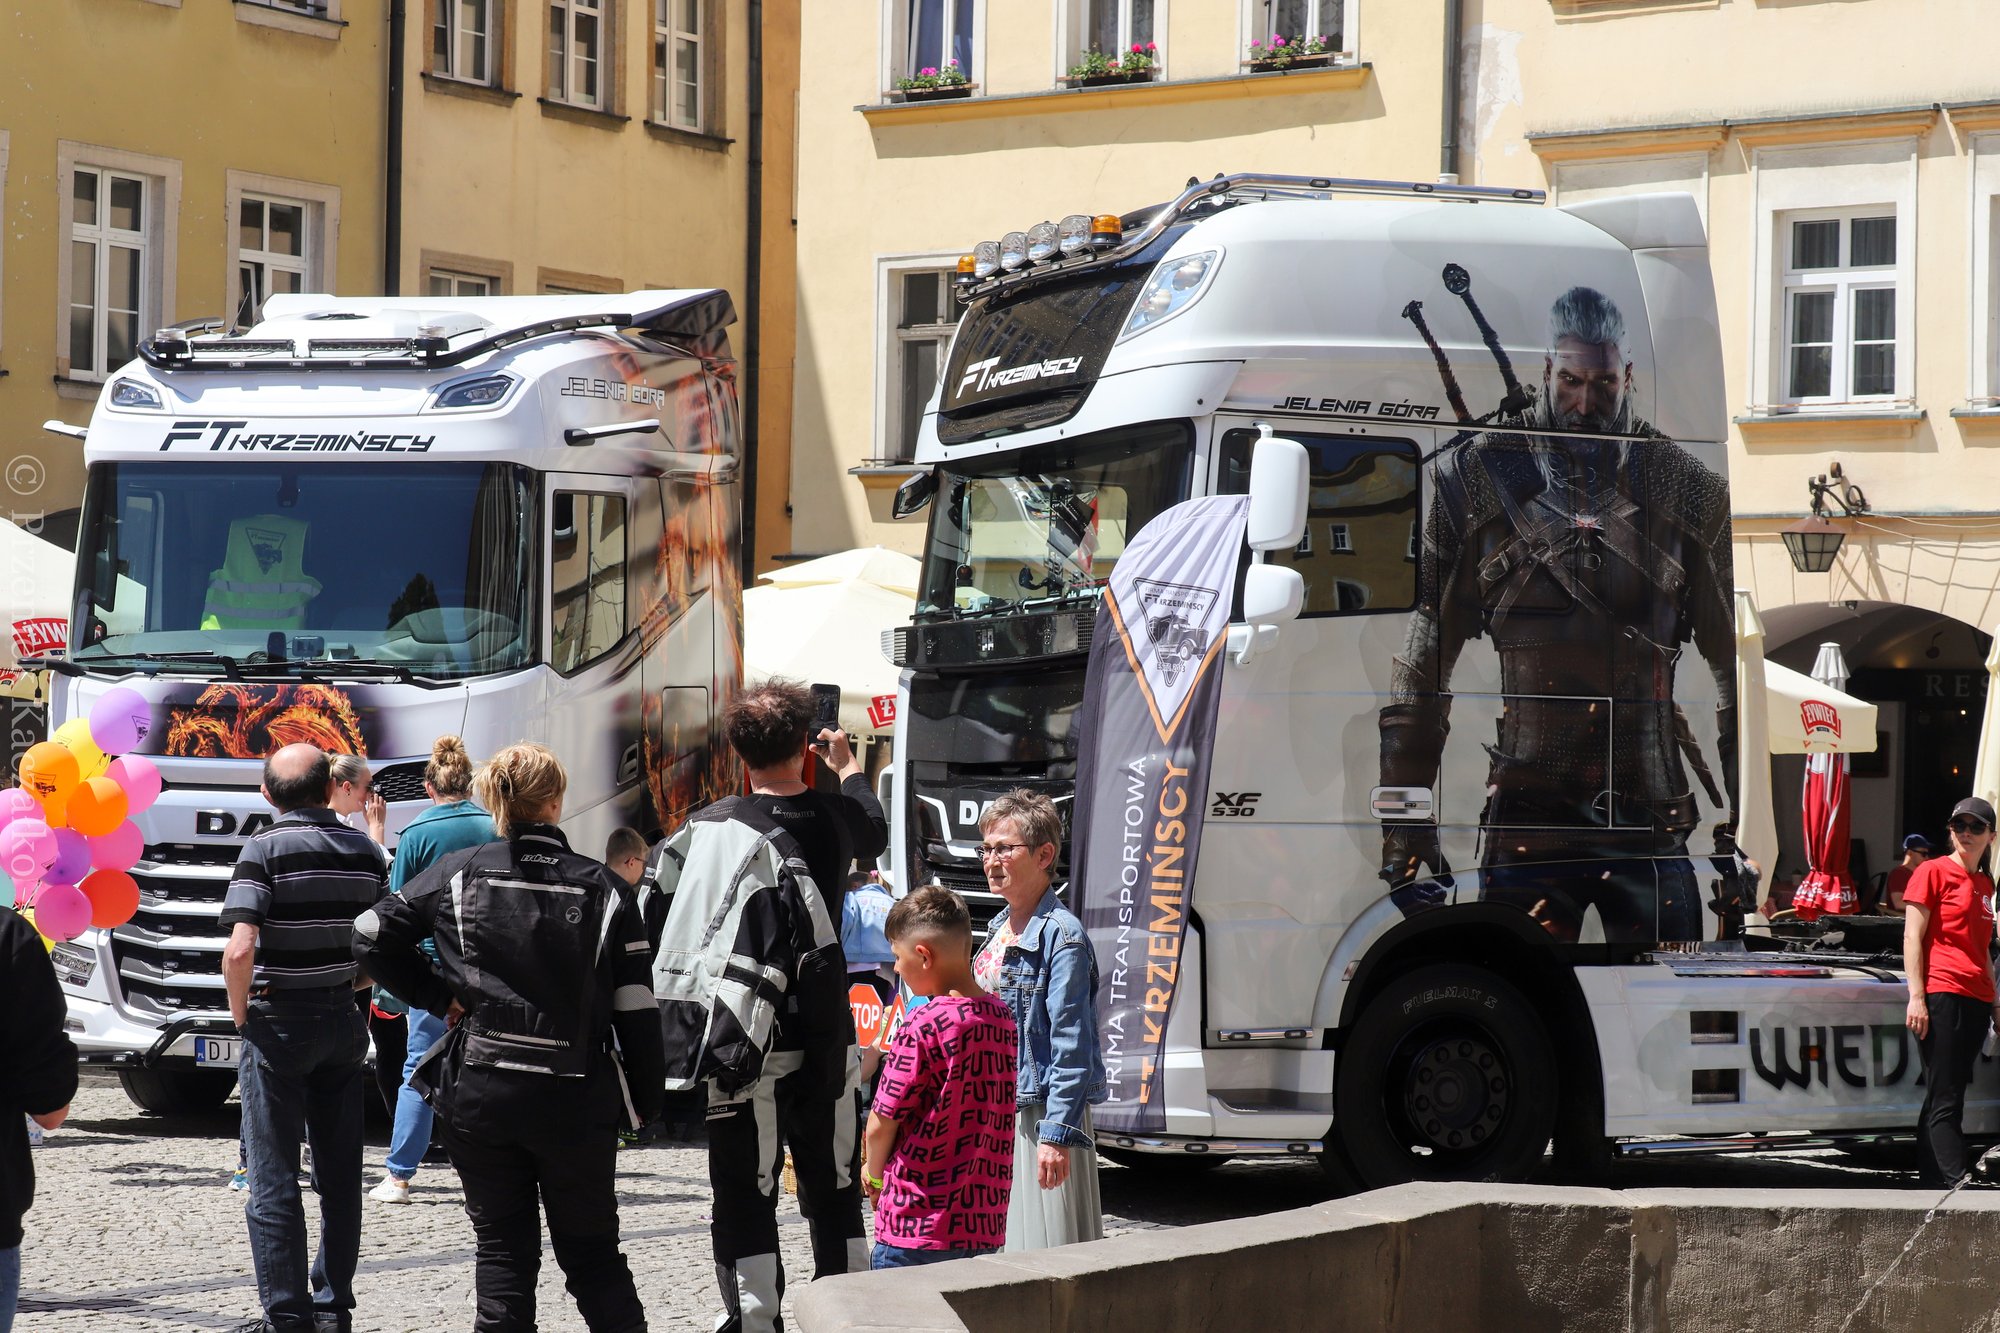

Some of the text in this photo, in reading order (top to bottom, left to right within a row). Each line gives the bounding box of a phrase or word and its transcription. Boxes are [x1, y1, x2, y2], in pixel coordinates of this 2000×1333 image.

[956, 356, 1083, 399] FT KRZEMIŃSCY
[561, 377, 665, 410] JELENIA GÓRA
[1273, 396, 1440, 419] JELENIA GÓRA
[159, 421, 436, 452] FT KRZEMIŃSCY
[1803, 702, 1836, 726] ŻYWIEC
[1211, 792, 1262, 806] XF
[1212, 807, 1255, 816] 530
[1110, 756, 1147, 1005] TRANSPORTOWA
[1143, 757, 1188, 1044] KRZEMIŃSCY
[850, 1002, 880, 1030] TOP
[1749, 1024, 1926, 1090] WIED
[961, 1081, 1017, 1105] FUTUR
[959, 1109, 1015, 1132] FUTUR
